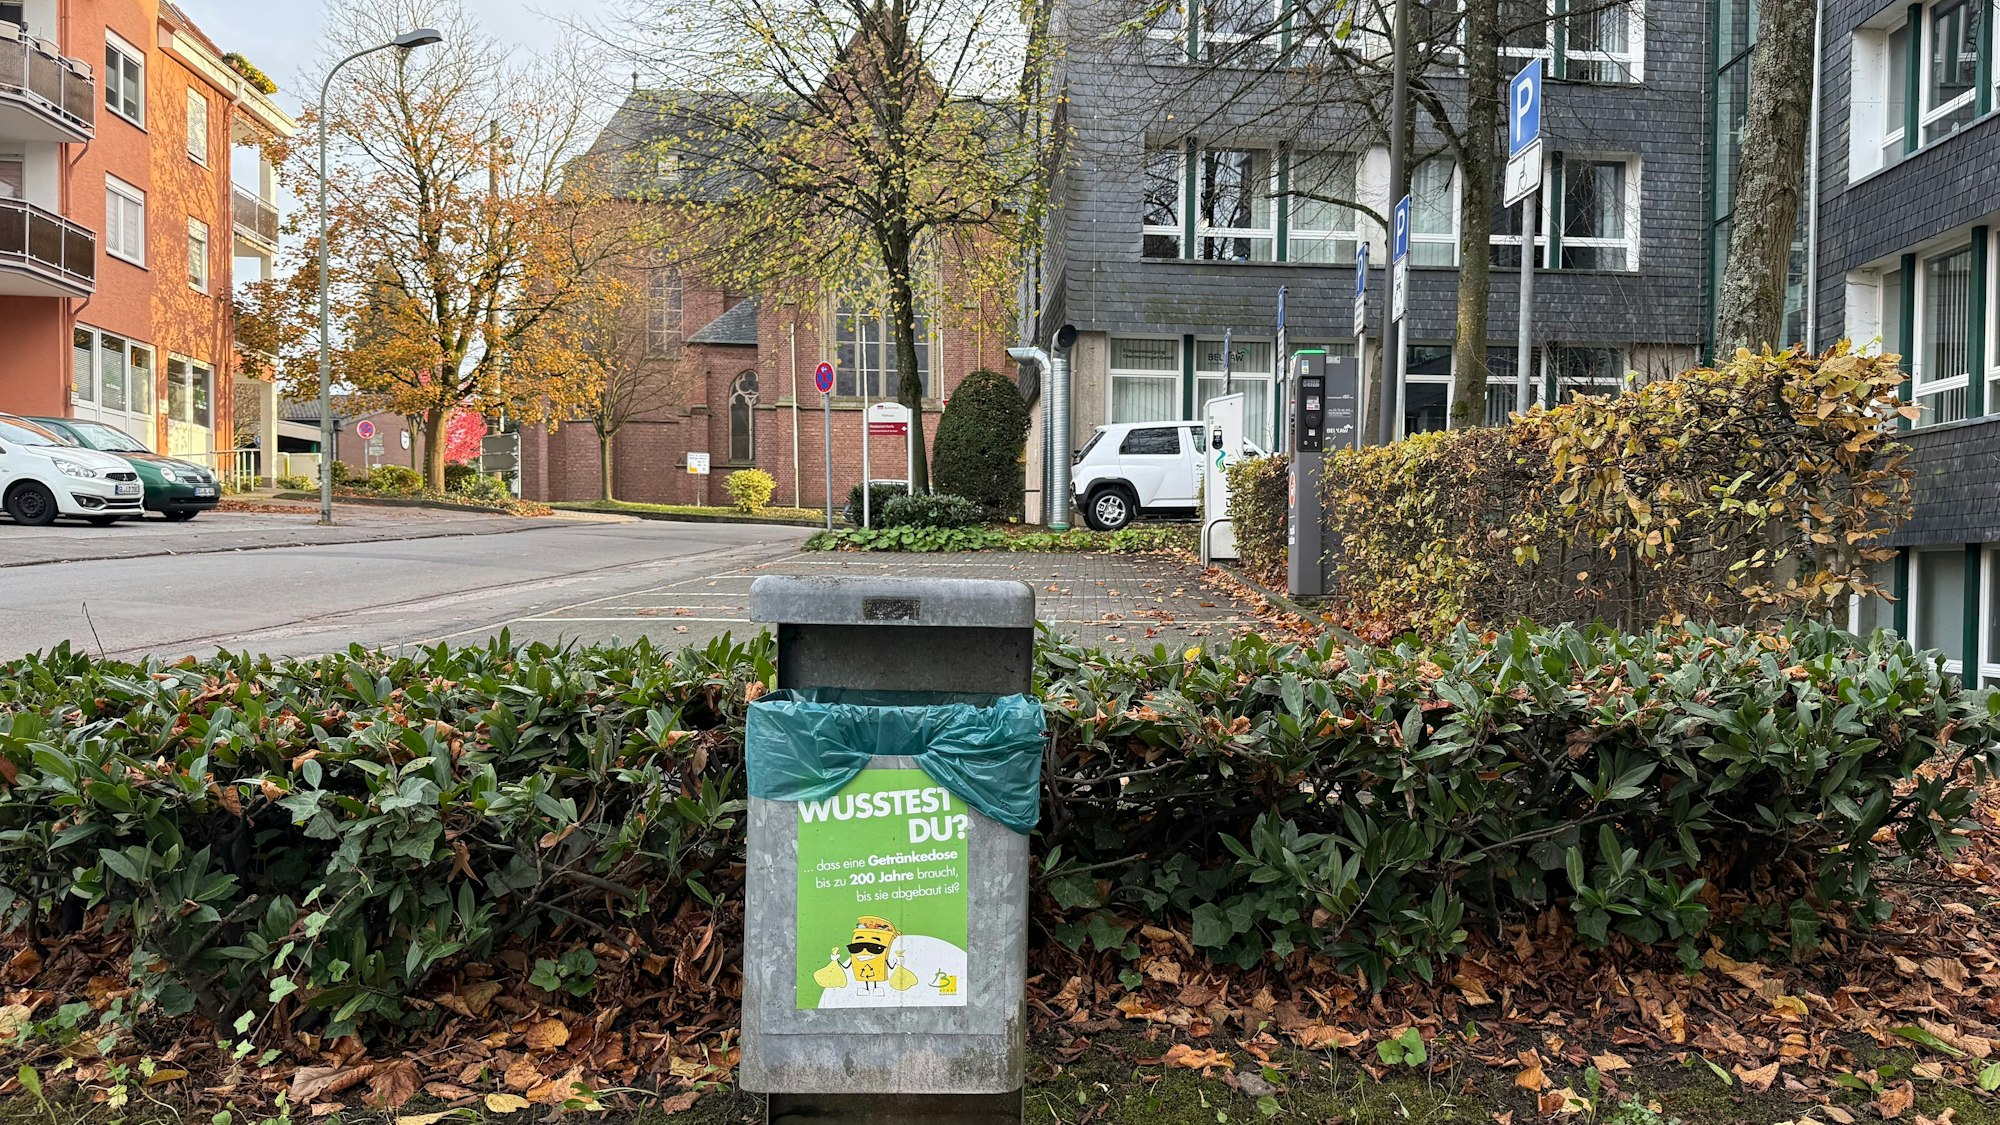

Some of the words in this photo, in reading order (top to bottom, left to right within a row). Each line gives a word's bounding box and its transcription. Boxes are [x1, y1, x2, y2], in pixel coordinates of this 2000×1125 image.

[1516, 77, 1533, 143] P
[1395, 207, 1405, 254] P
[1357, 255, 1363, 291] P
[1208, 352, 1244, 362] BELAW
[797, 786, 951, 824] WUSSTEST
[908, 813, 968, 844] DU?
[816, 859, 841, 872] dass
[842, 858, 866, 869] eine
[867, 849, 959, 867] Getränkedose
[815, 876, 831, 889] bis
[833, 878, 847, 888] zu
[849, 872, 876, 886] 200
[878, 869, 914, 884] Jahre
[917, 866, 959, 880] braucht,
[856, 890, 872, 902] bis
[874, 888, 889, 901] sie
[891, 886, 942, 901] abgebaut
[944, 882, 961, 894] ist?
